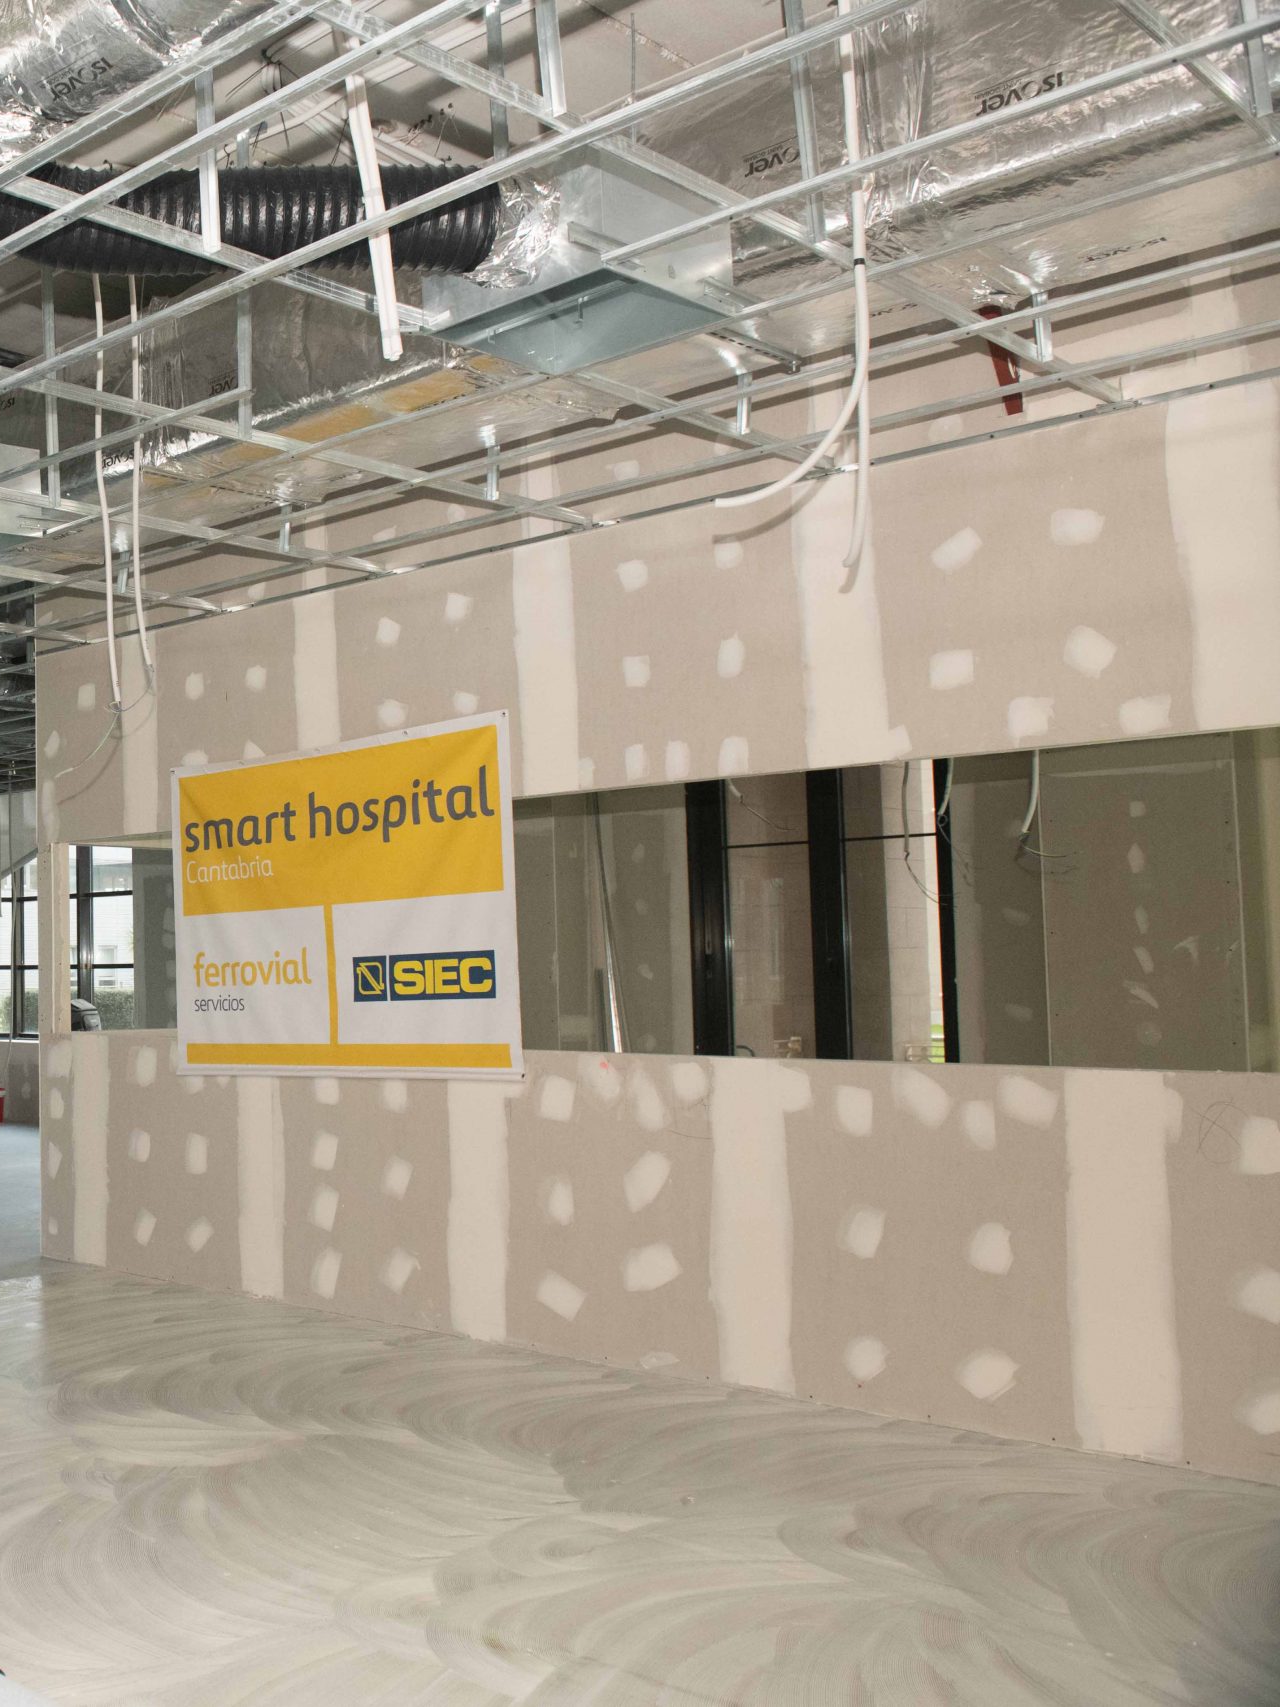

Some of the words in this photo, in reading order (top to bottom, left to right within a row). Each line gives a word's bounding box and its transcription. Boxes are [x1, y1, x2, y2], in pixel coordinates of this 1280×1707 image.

[185, 802, 296, 853] smart
[308, 765, 495, 843] hospital
[186, 855, 274, 884] Cantabria
[193, 946, 312, 988] ferrovial
[393, 957, 493, 995] SIEC
[194, 994, 245, 1012] servicios
